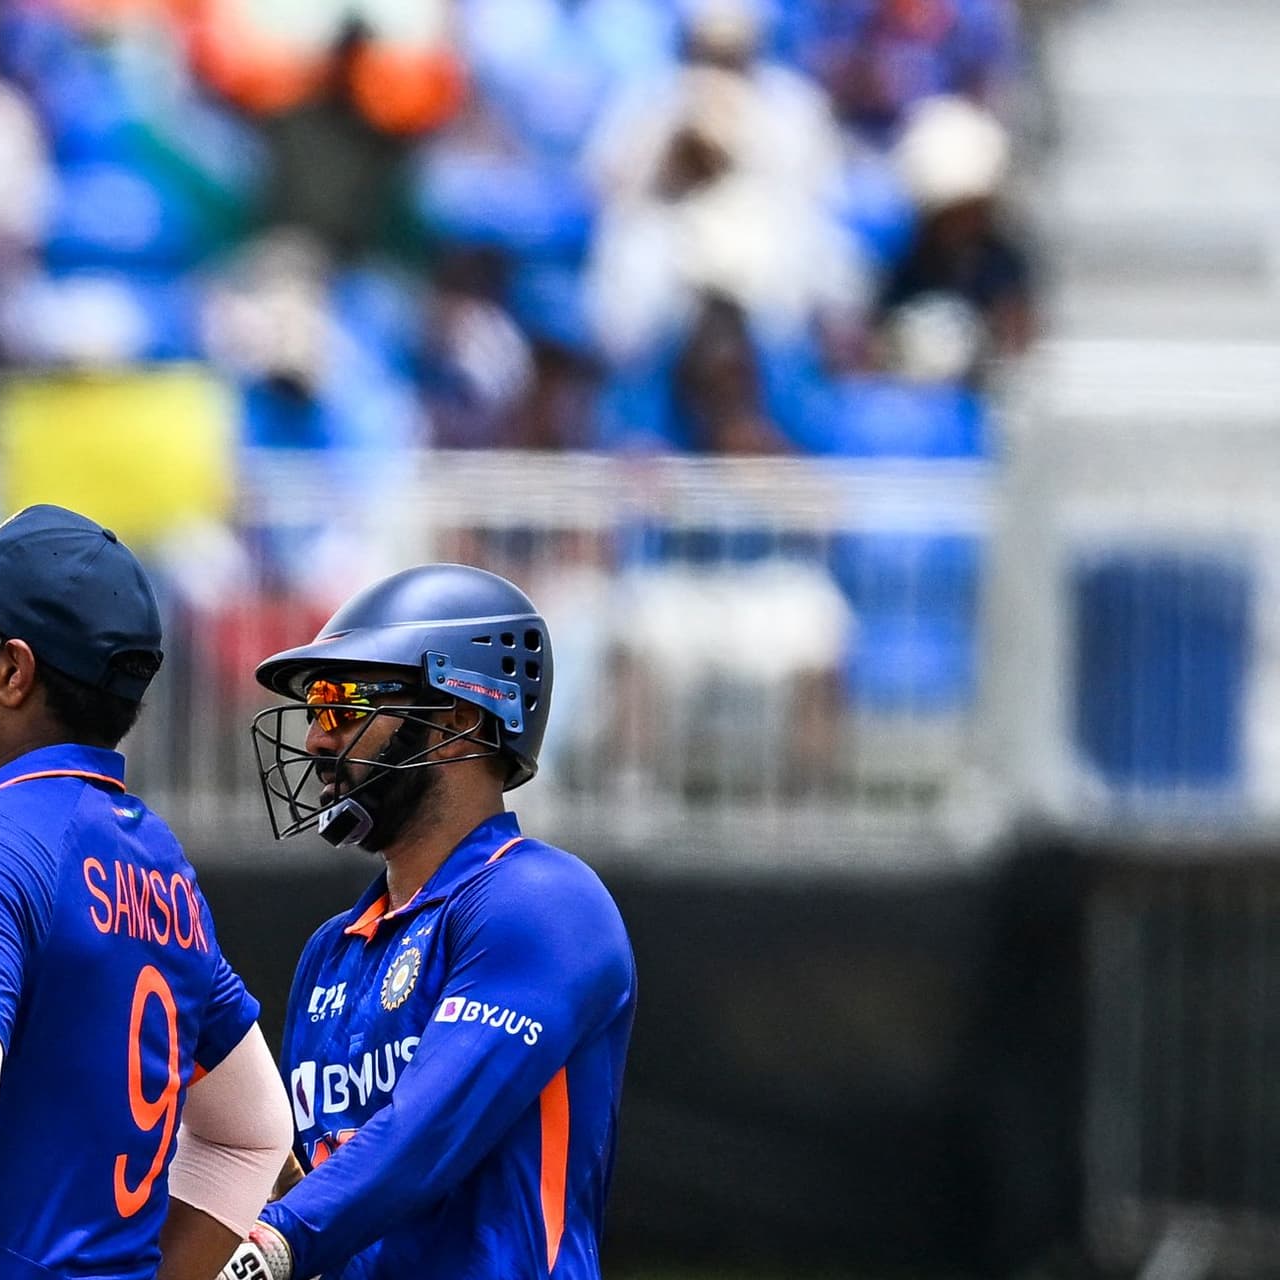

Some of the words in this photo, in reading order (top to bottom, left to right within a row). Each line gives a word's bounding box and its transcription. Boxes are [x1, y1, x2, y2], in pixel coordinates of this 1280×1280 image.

[83, 857, 208, 953] SAMSON
[461, 1001, 543, 1046] BYJU'S
[114, 965, 179, 1218] 9
